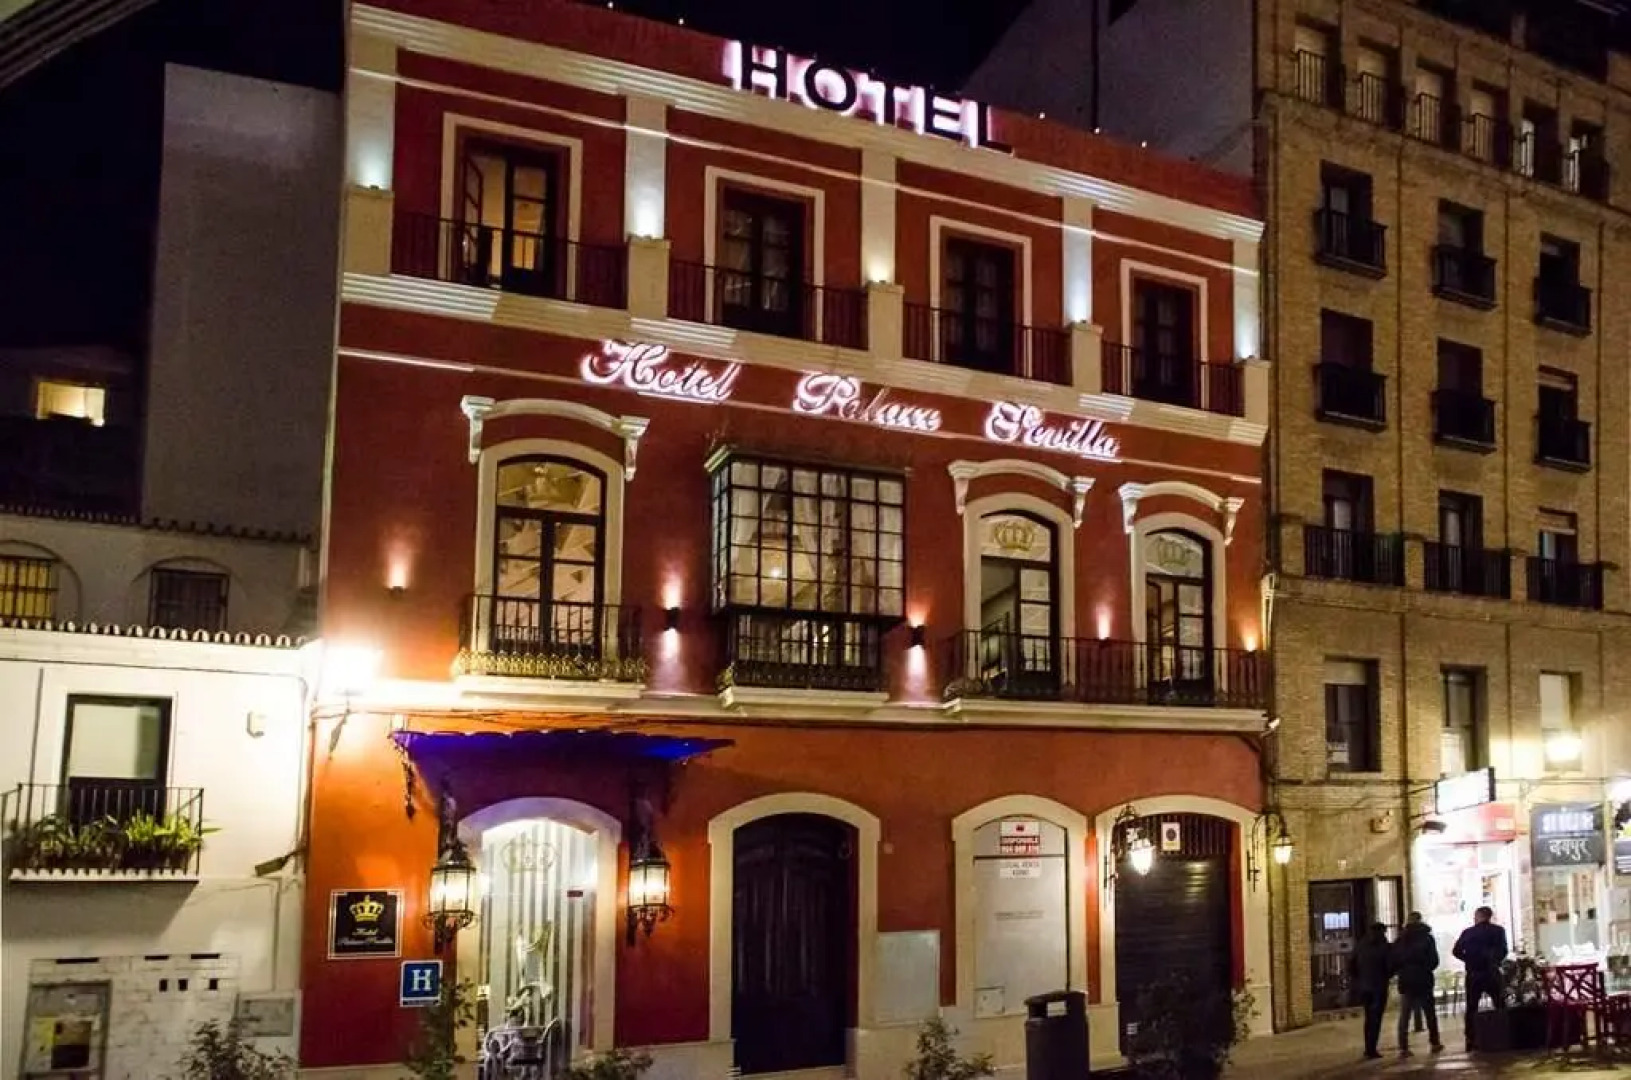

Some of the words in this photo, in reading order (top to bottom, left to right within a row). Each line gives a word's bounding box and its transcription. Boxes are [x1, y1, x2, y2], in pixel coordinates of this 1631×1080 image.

[728, 38, 1013, 154] HOTEL
[581, 339, 742, 404] Hotel
[984, 400, 1120, 460] Sevilla
[411, 968, 433, 992] H
